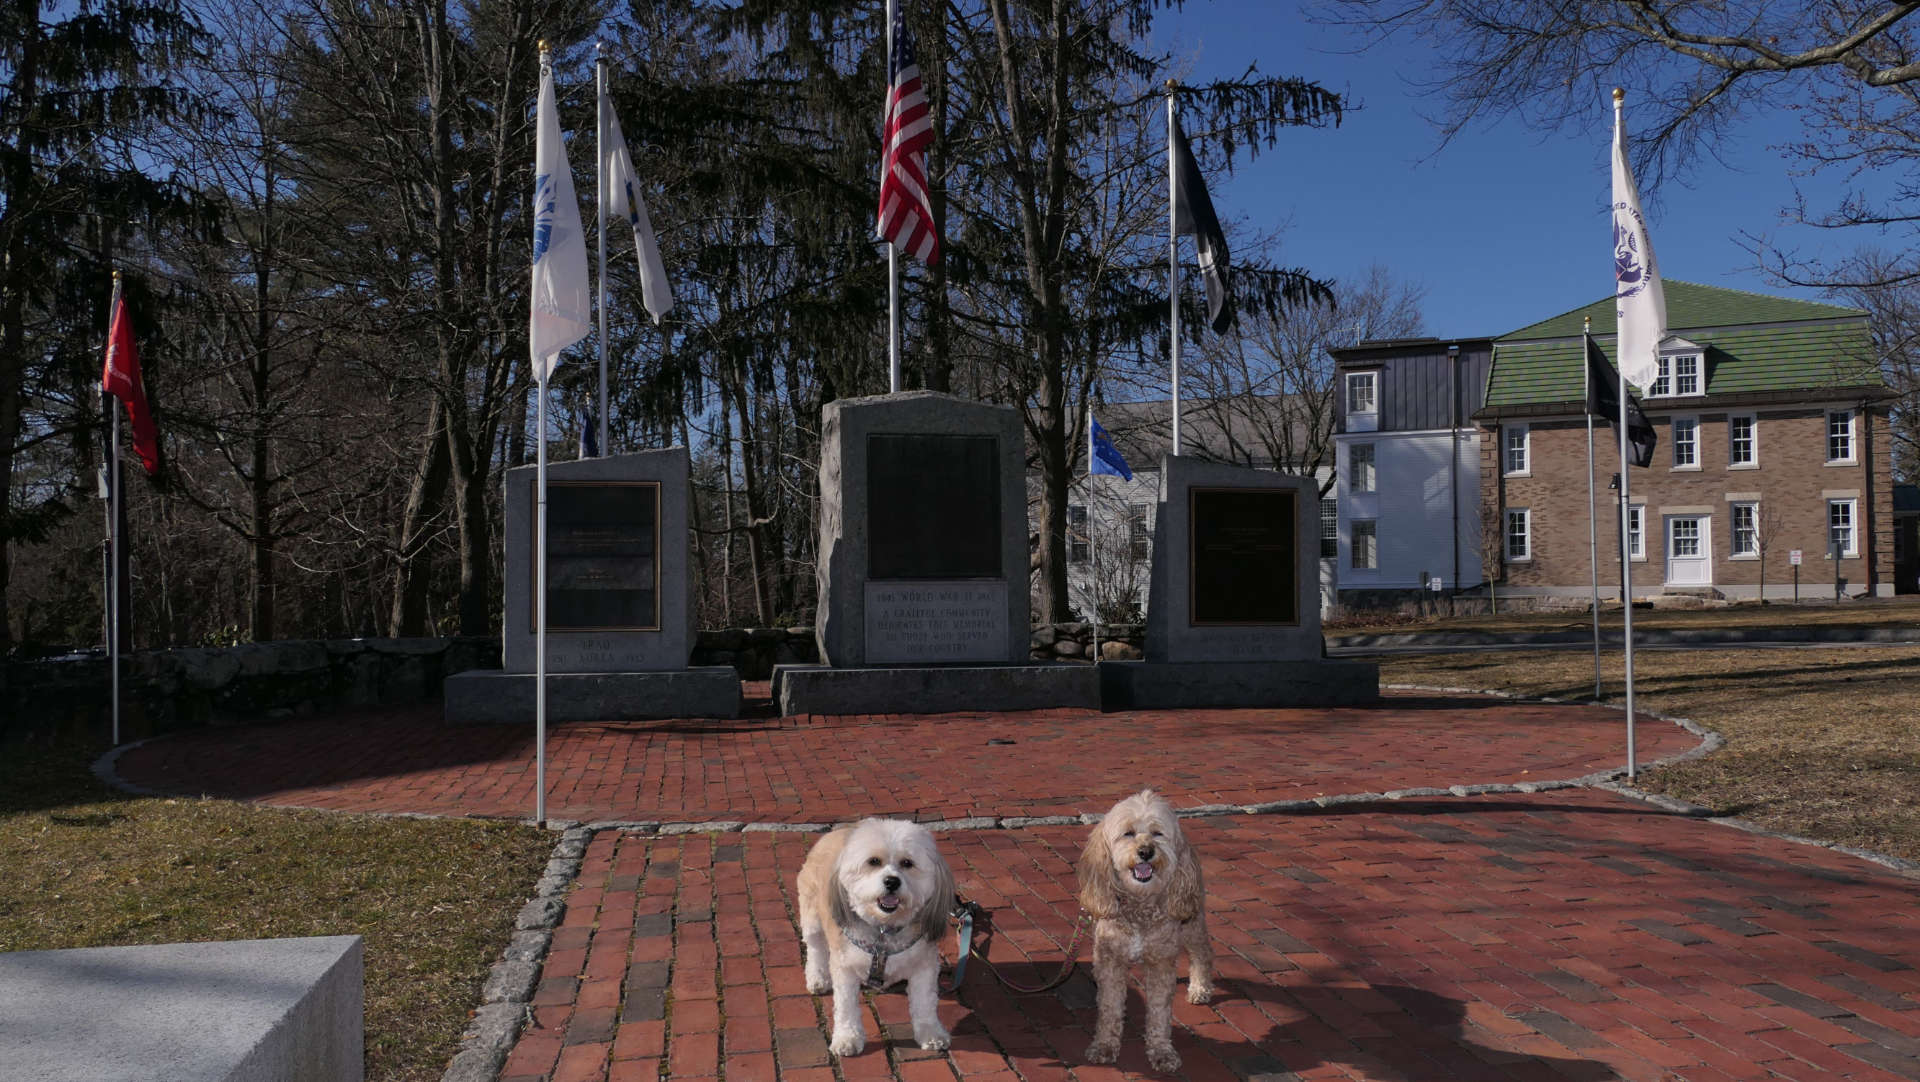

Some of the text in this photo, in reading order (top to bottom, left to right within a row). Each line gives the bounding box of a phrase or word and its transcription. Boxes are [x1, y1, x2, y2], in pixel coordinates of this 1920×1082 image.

[901, 591, 934, 602] WORLD
[939, 591, 958, 602] WAR
[894, 607, 935, 618] GRATEFUL
[940, 607, 991, 617] COMMUNITY
[952, 619, 995, 630] MEMORIAL
[957, 631, 989, 641] SERVED
